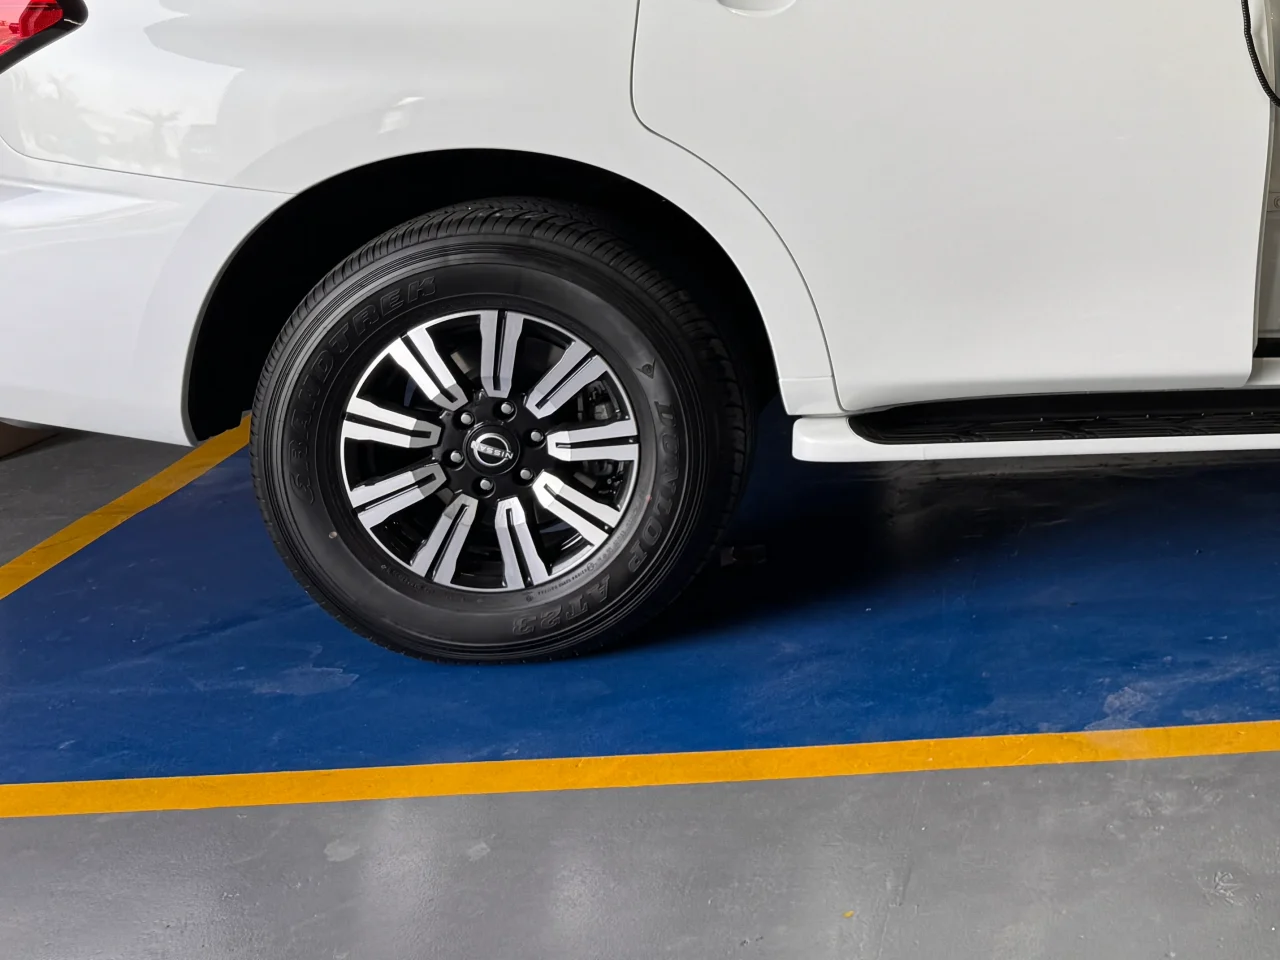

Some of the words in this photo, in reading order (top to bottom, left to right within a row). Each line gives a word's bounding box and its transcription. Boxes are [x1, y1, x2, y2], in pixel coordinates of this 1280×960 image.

[288, 276, 438, 504] GRANDTREK
[470, 440, 514, 460] NISSAN
[628, 401, 680, 574] DUNLOP
[512, 574, 611, 636] AT23
